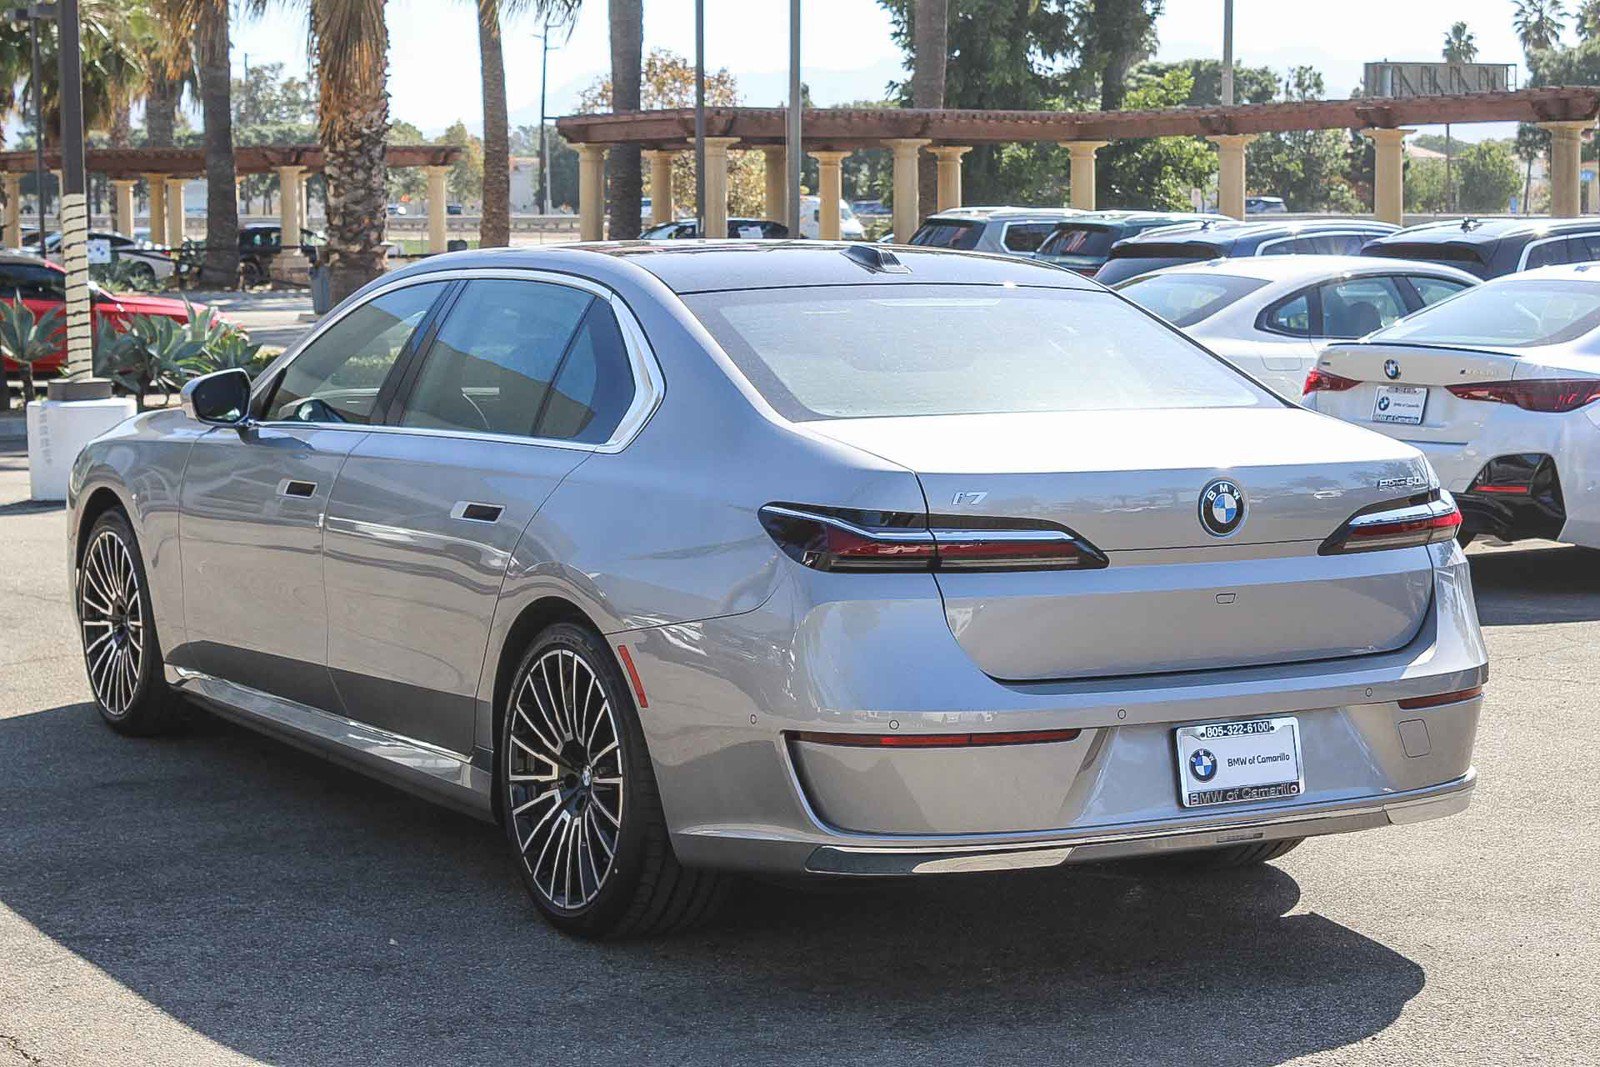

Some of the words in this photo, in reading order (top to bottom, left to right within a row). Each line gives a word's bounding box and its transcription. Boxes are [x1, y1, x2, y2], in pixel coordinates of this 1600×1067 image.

[950, 491, 988, 506] i7
[1206, 484, 1241, 501] BMW
[1206, 721, 1269, 737] 805-322-6100
[1227, 756, 1247, 768] BMW
[1248, 755, 1256, 765] of
[1257, 752, 1290, 764] Camarillo
[1190, 791, 1223, 805] BMW
[1226, 789, 1239, 801] of
[1241, 783, 1299, 799] Camarillo
